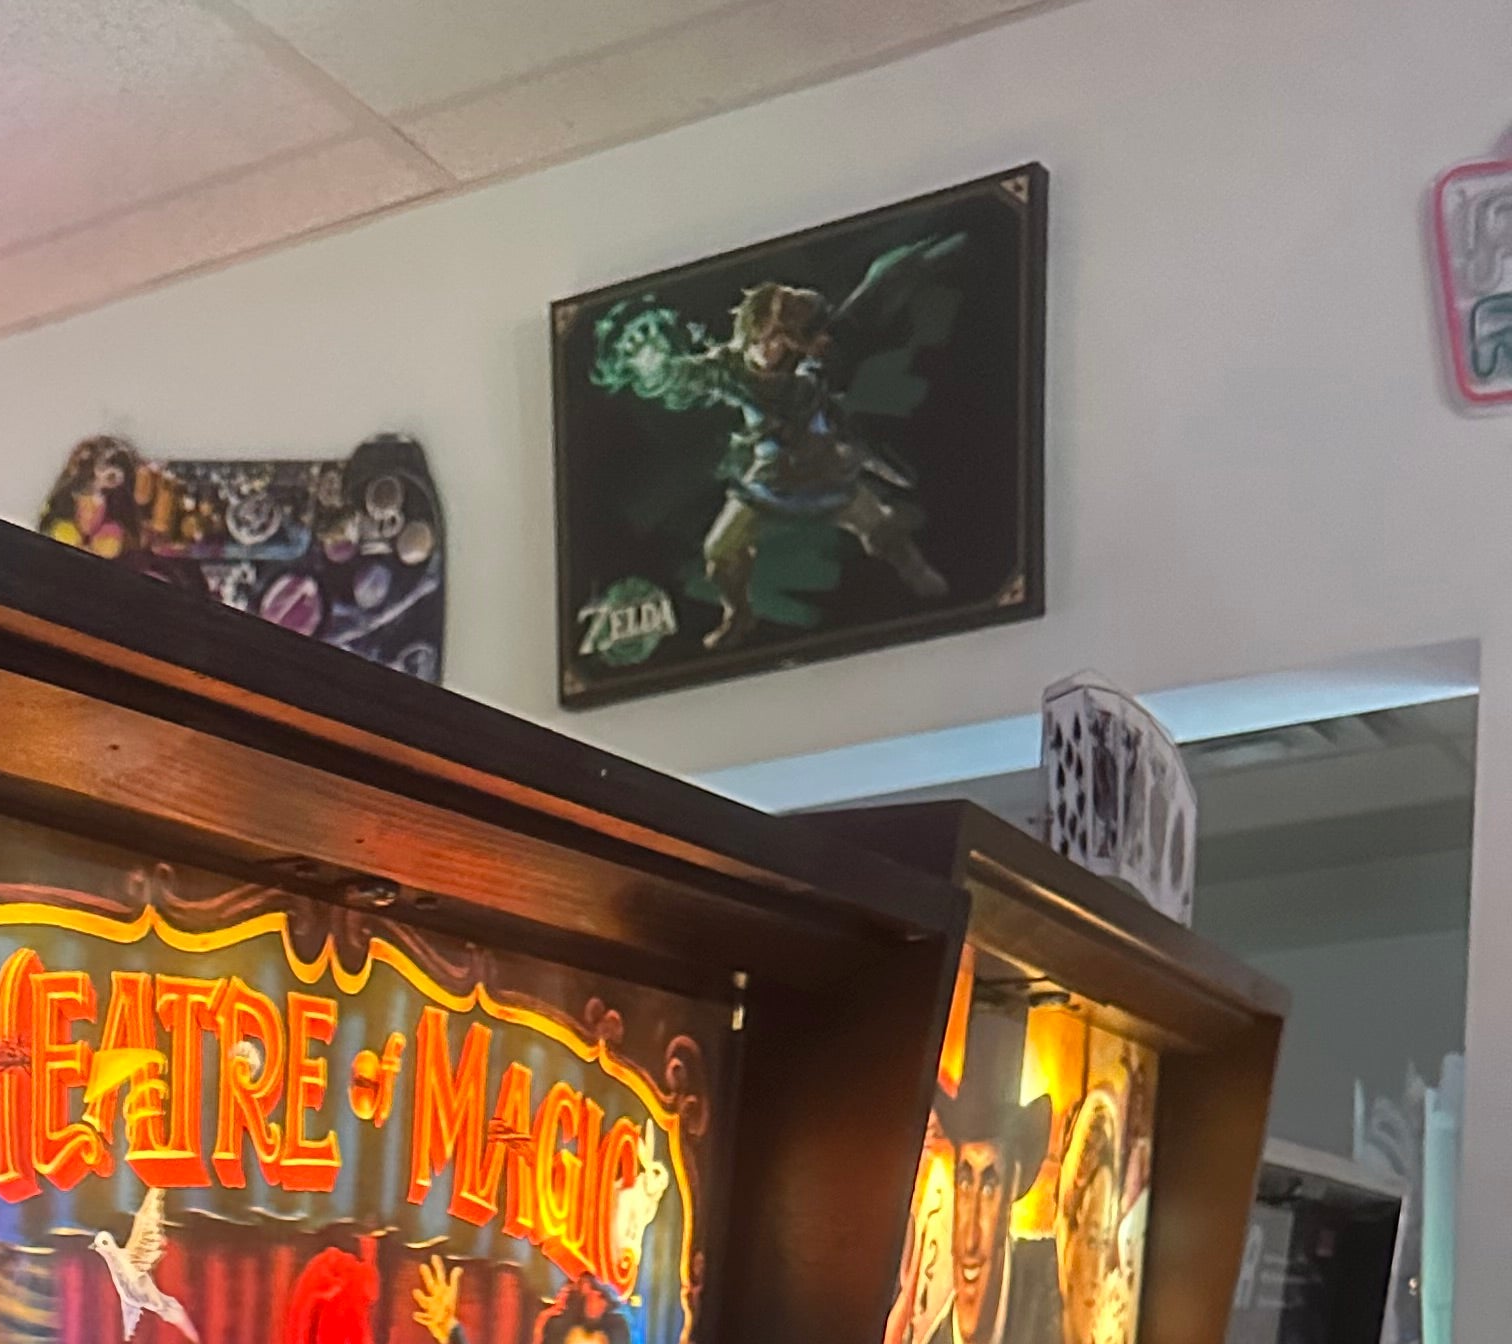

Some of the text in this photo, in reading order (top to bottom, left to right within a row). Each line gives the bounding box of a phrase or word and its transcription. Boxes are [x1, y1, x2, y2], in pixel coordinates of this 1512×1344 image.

[577, 590, 678, 655] ZELDA
[347, 1031, 406, 1128] of
[409, 1006, 651, 1299] MAGIC
